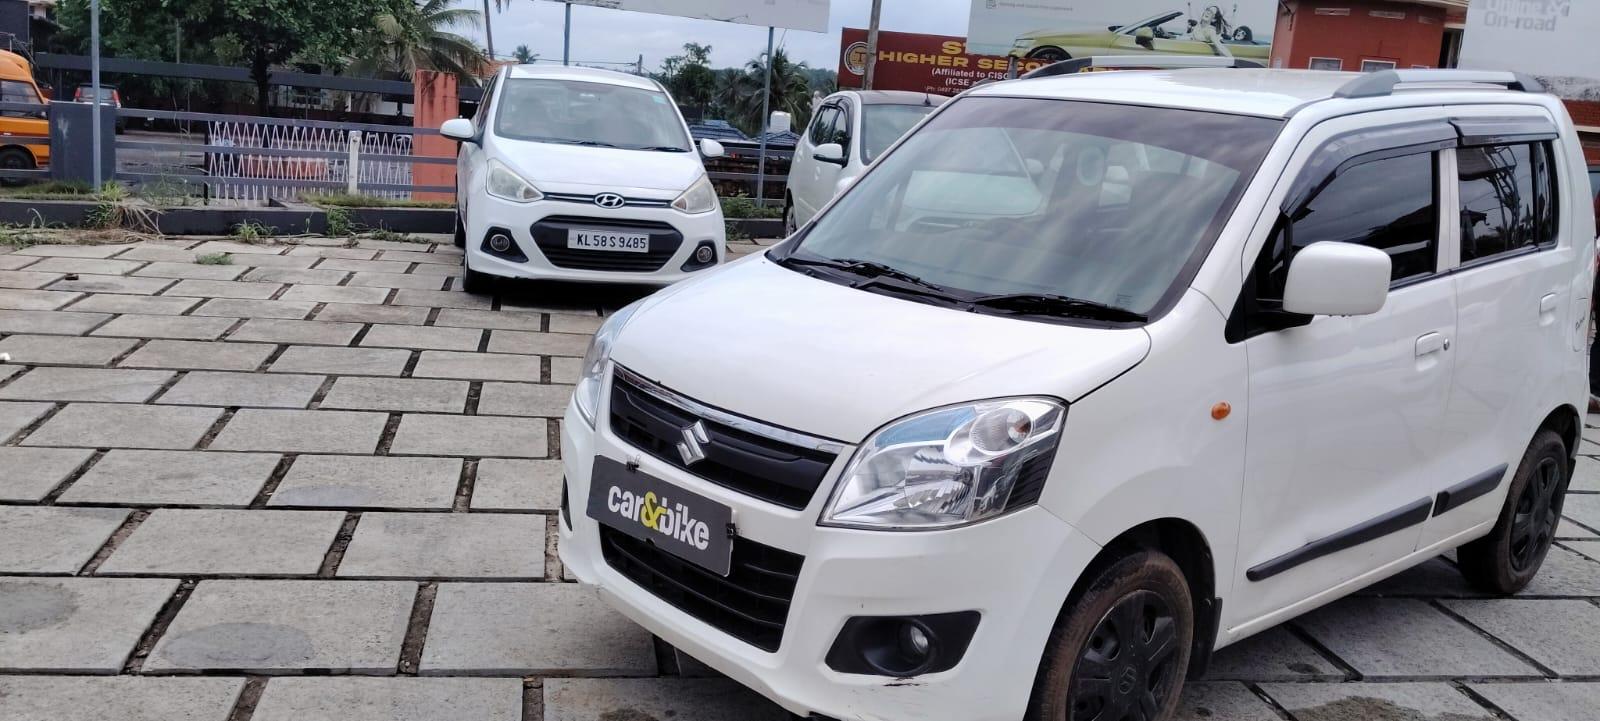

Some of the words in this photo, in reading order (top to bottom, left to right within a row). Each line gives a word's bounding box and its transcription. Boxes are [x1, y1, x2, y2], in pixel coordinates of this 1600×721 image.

[1484, 11, 1556, 31] On-road
[941, 41, 967, 55] S
[879, 52, 969, 67] HIGHER
[931, 67, 975, 78] (Affiliated
[577, 234, 590, 246] KL
[593, 235, 608, 248] 58
[609, 236, 616, 247] S
[619, 236, 647, 249] 9485
[607, 485, 710, 550] car&bike
